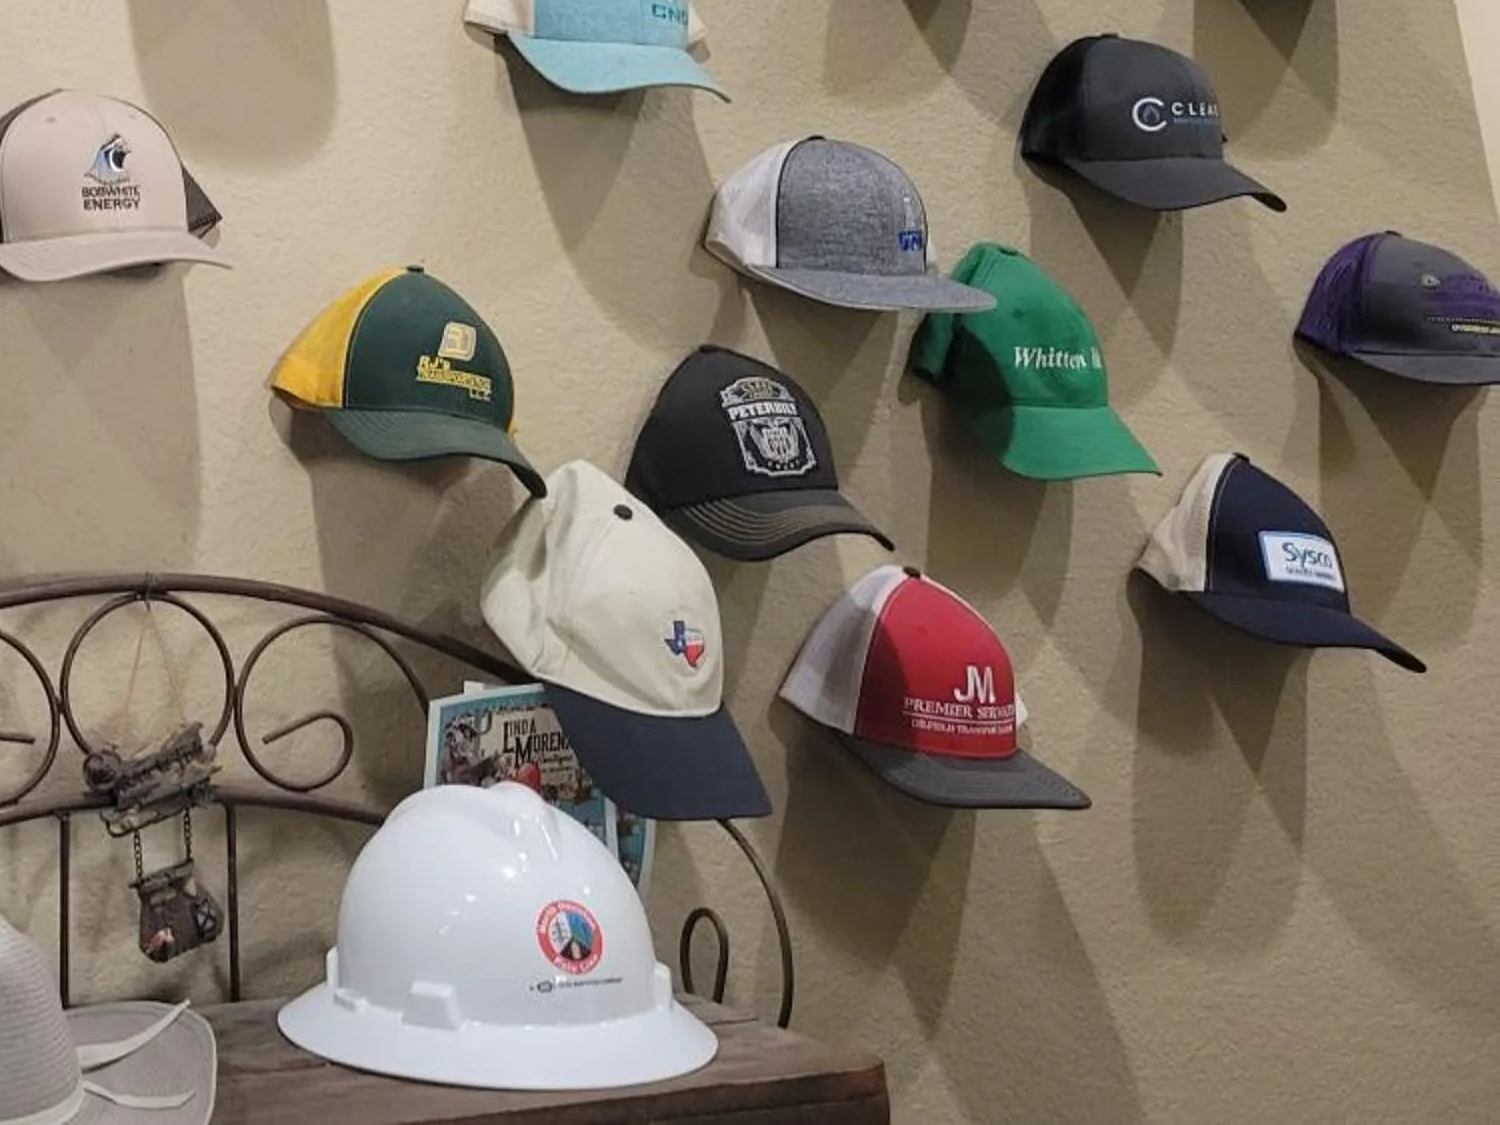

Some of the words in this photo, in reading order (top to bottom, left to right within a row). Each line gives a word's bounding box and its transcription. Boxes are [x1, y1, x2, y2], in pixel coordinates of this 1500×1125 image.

[83, 198, 141, 212] ENERGY
[1013, 346, 1088, 370] Whitten
[1281, 541, 1333, 568] Sysco
[952, 665, 996, 704] JM
[904, 698, 972, 719] PREMIER
[503, 718, 537, 754] LINDA
[515, 731, 571, 769] MOREN
